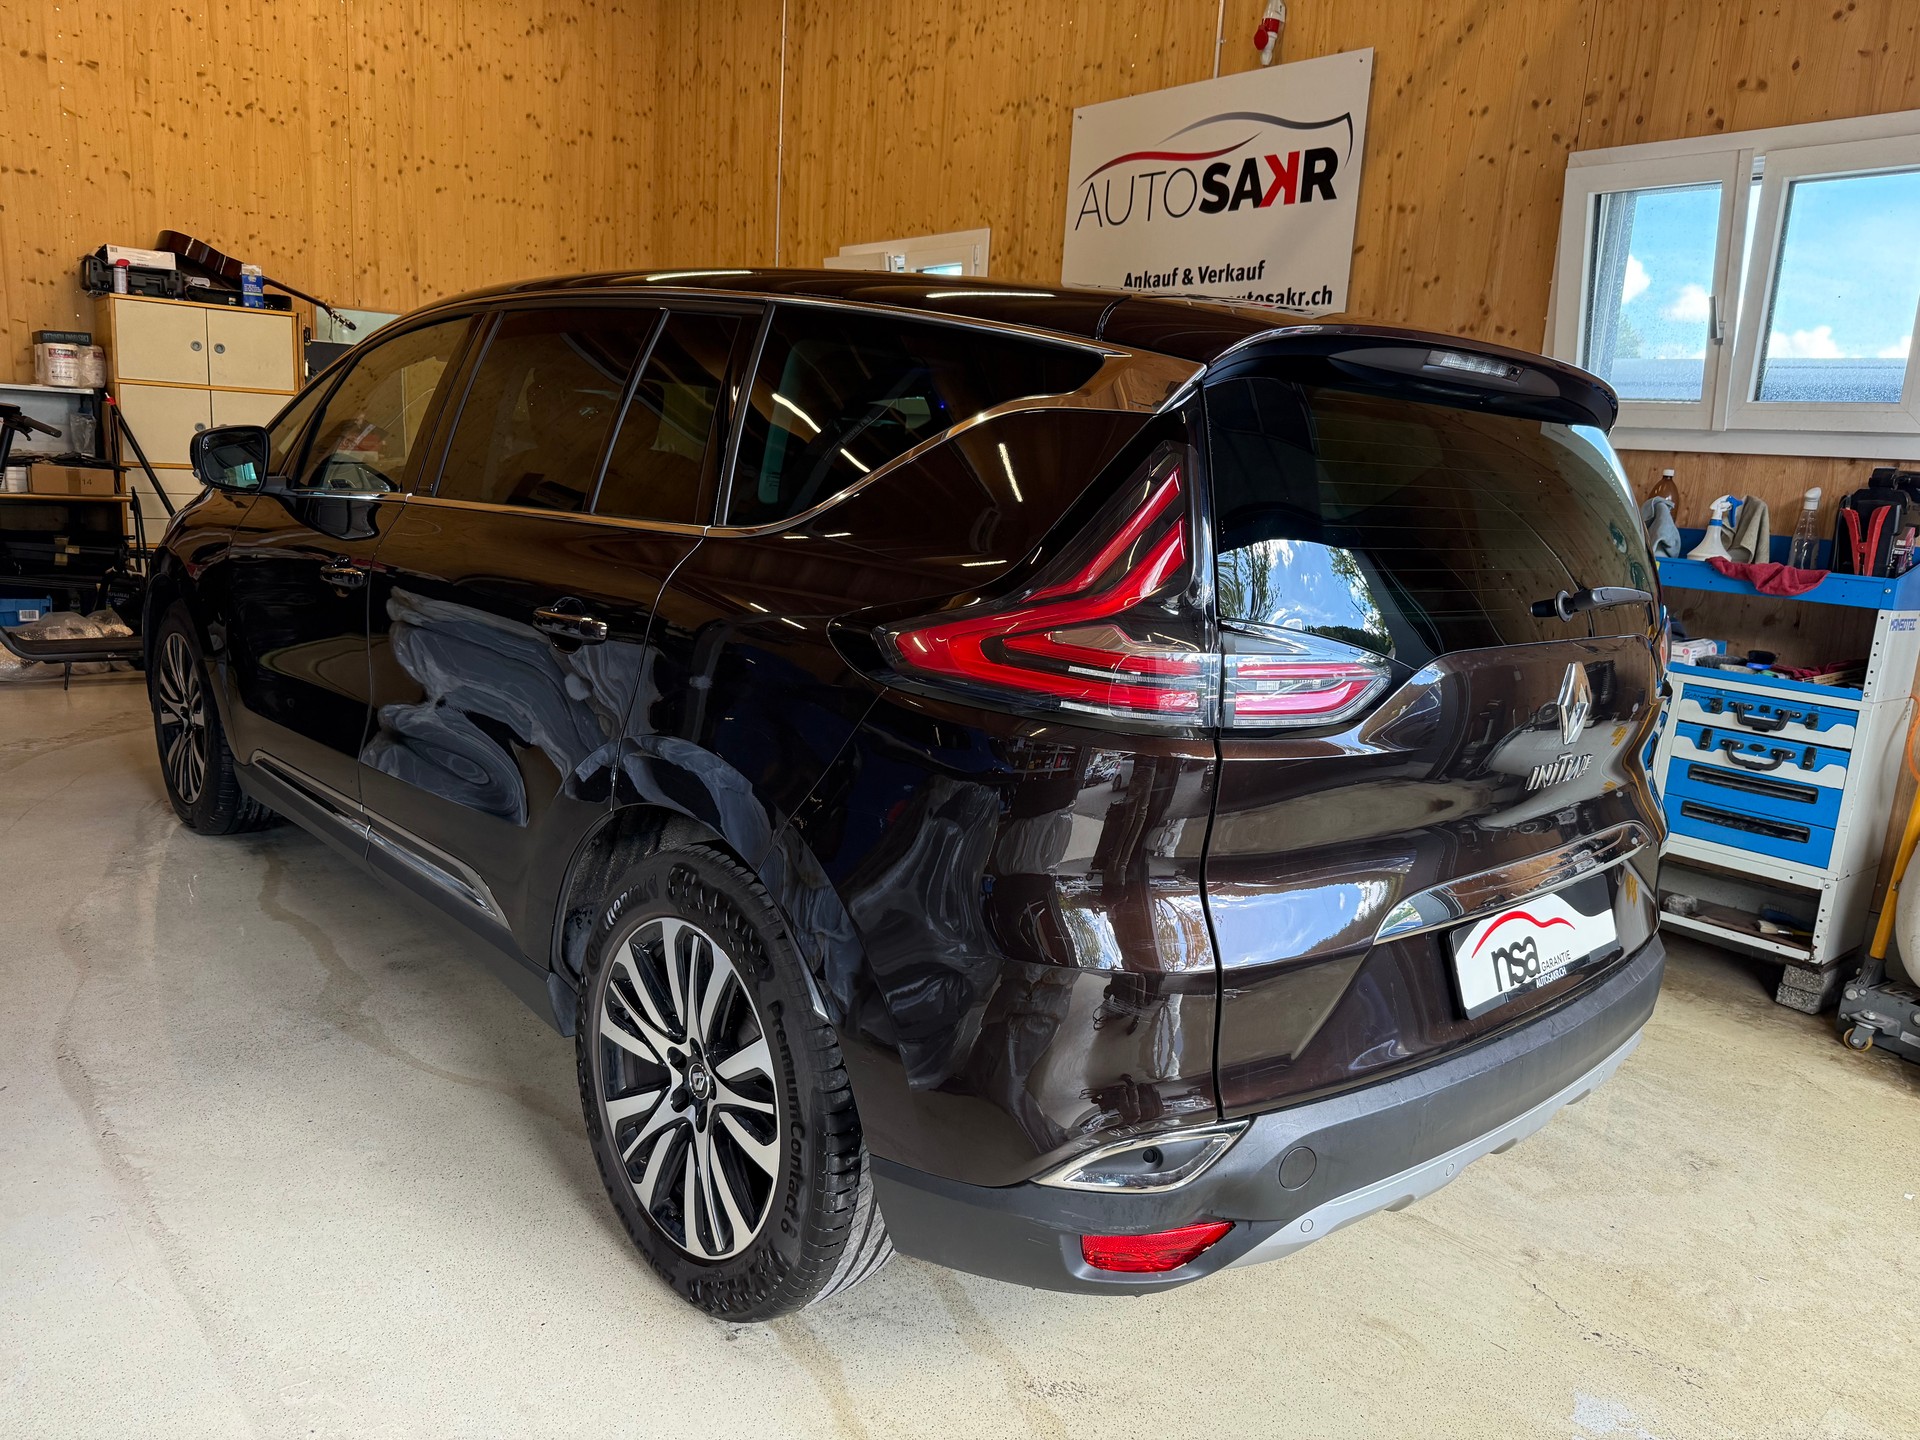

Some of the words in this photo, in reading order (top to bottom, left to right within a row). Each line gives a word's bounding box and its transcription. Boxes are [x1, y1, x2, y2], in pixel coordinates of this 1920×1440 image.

[1074, 146, 1339, 231] AUTOSAKR
[1124, 266, 1179, 289] Ankauf
[1181, 268, 1194, 286] &
[1198, 259, 1266, 284] Verkauf
[1491, 936, 1541, 992] nsa
[1541, 949, 1571, 972] GARANTIE
[780, 1217, 799, 1239] 6
